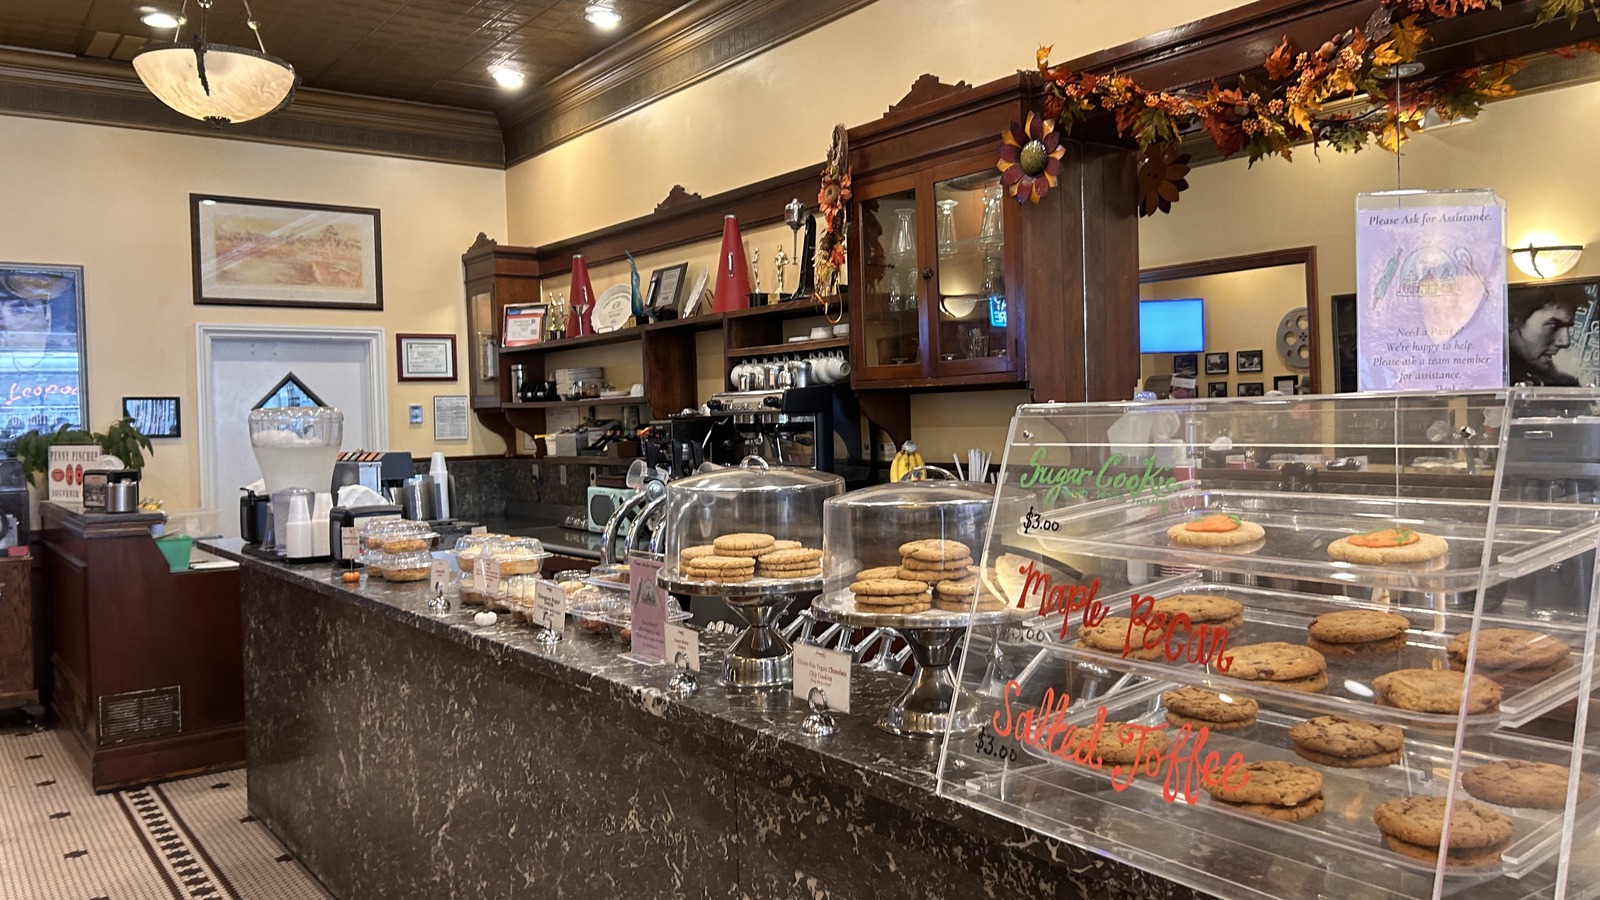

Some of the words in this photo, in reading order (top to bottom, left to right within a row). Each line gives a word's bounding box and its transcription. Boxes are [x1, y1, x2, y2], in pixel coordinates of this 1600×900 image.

[1369, 215, 1399, 226] Please
[1401, 213, 1419, 224] Ask
[1420, 212, 1436, 227] for
[1438, 211, 1492, 224] Assistance.
[1396, 328, 1419, 338] Need
[1386, 342, 1410, 352] We're
[1412, 341, 1440, 354] happy
[1442, 342, 1452, 351] to
[1453, 340, 1475, 352] help.
[1373, 357, 1400, 367] Please
[1401, 356, 1417, 366] ask
[1427, 357, 1451, 365] team
[1453, 353, 1491, 365] member
[1399, 371, 1413, 384] for
[1414, 371, 1461, 380] assistance.
[1020, 446, 1093, 508] Sugar
[1023, 506, 1060, 534] $3.00
[1017, 560, 1110, 640] Maple
[1121, 594, 1234, 673] Pecan
[974, 726, 1018, 763] $3.00
[993, 680, 1107, 770] Salted
[1111, 722, 1249, 806] Toffee
